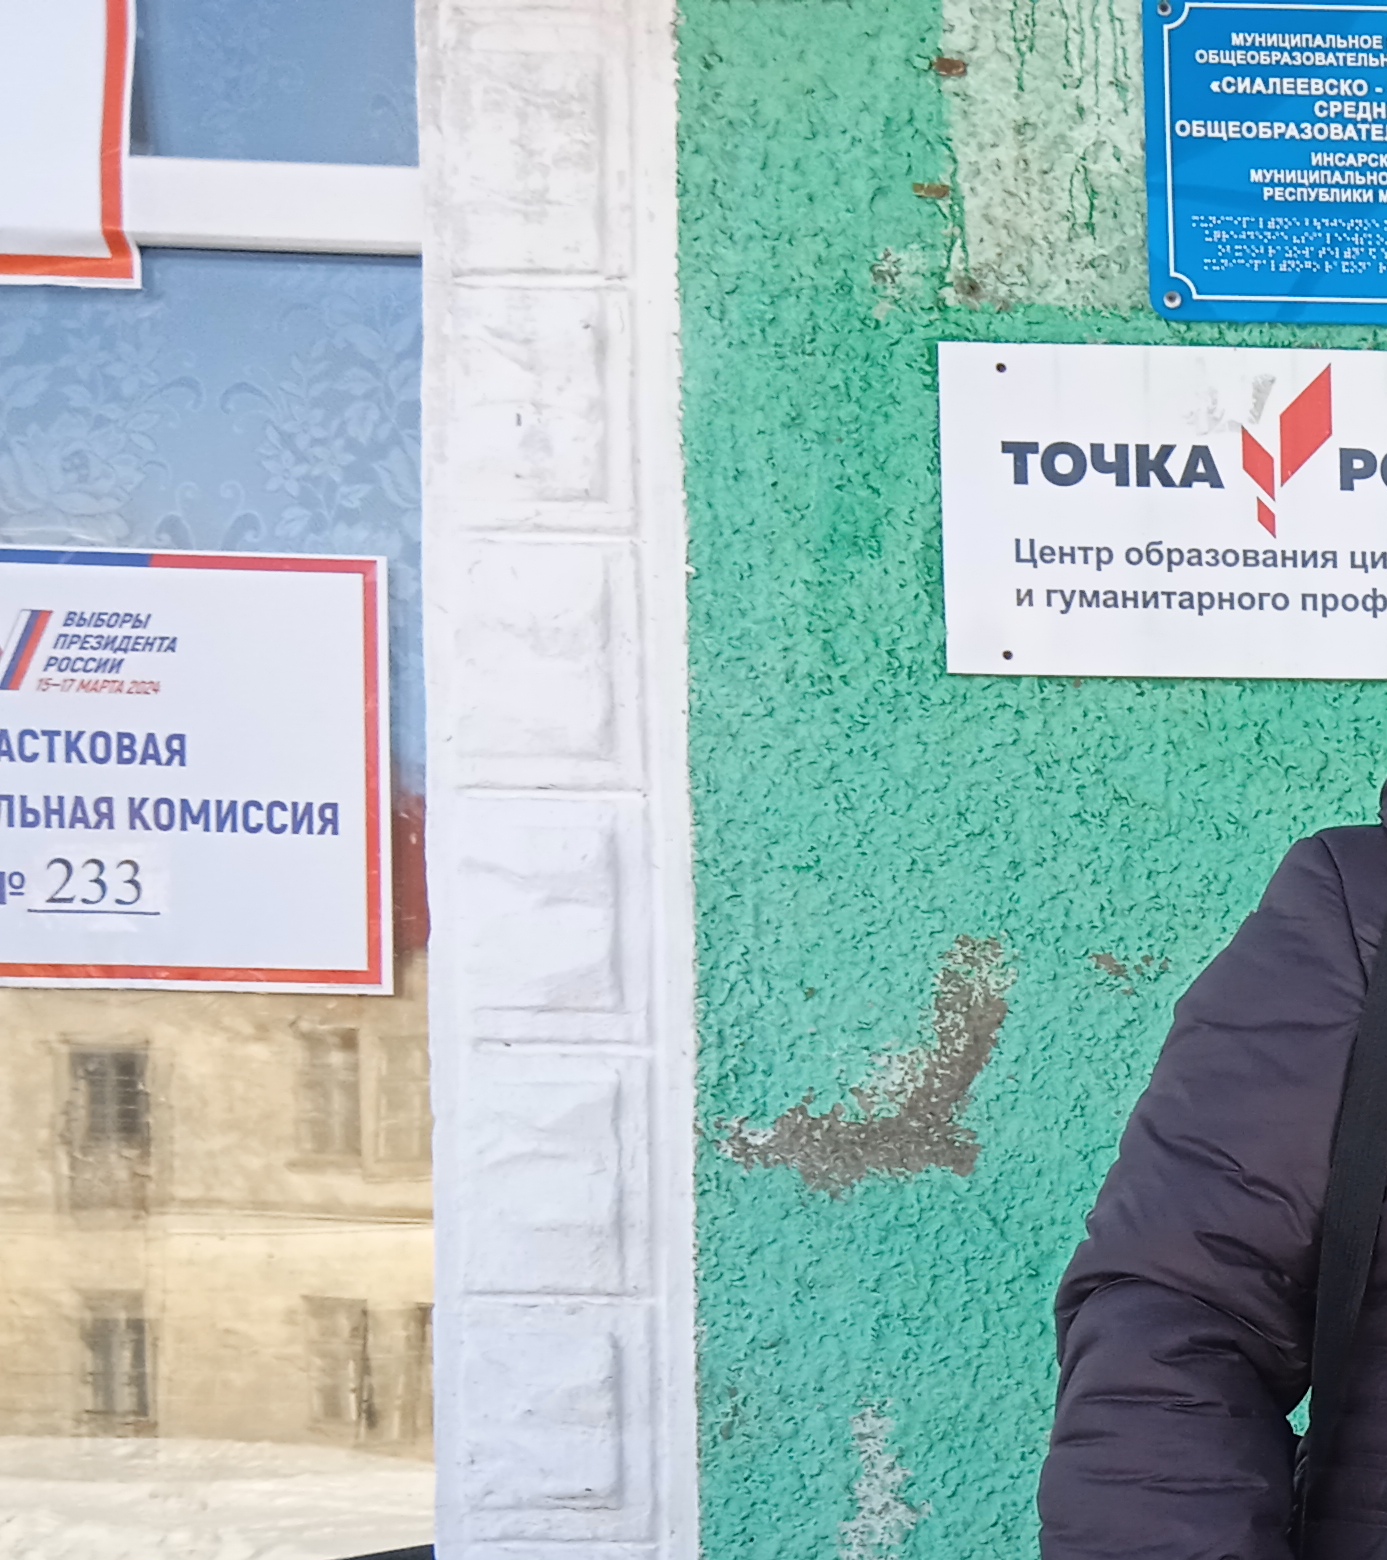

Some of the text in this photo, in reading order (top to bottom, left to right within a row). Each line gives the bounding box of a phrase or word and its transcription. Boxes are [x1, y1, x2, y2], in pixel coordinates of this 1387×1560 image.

[1231, 32, 1383, 50] МУНИЦИПАЛЬНОЕ
[1210, 76, 1368, 96] «СИАЛЕЕВСКО
[1263, 187, 1374, 204] РЕСПУБЛИКИ
[1000, 441, 1225, 489] ТОЧКА
[1014, 538, 1114, 571] Центр
[1124, 541, 1338, 571] образования
[1016, 587, 1034, 607] и
[1046, 589, 1290, 616] гуманитарного
[62, 611, 151, 630] ВЫБОРЫ
[52, 633, 177, 654] ПРЕЗИДЕНТА
[43, 656, 124, 675] РОССИИ
[76, 679, 124, 694] МАРТА
[126, 680, 161, 695] 2024
[129, 796, 339, 836] КОМИССИЯ
[45, 857, 142, 906] 233
